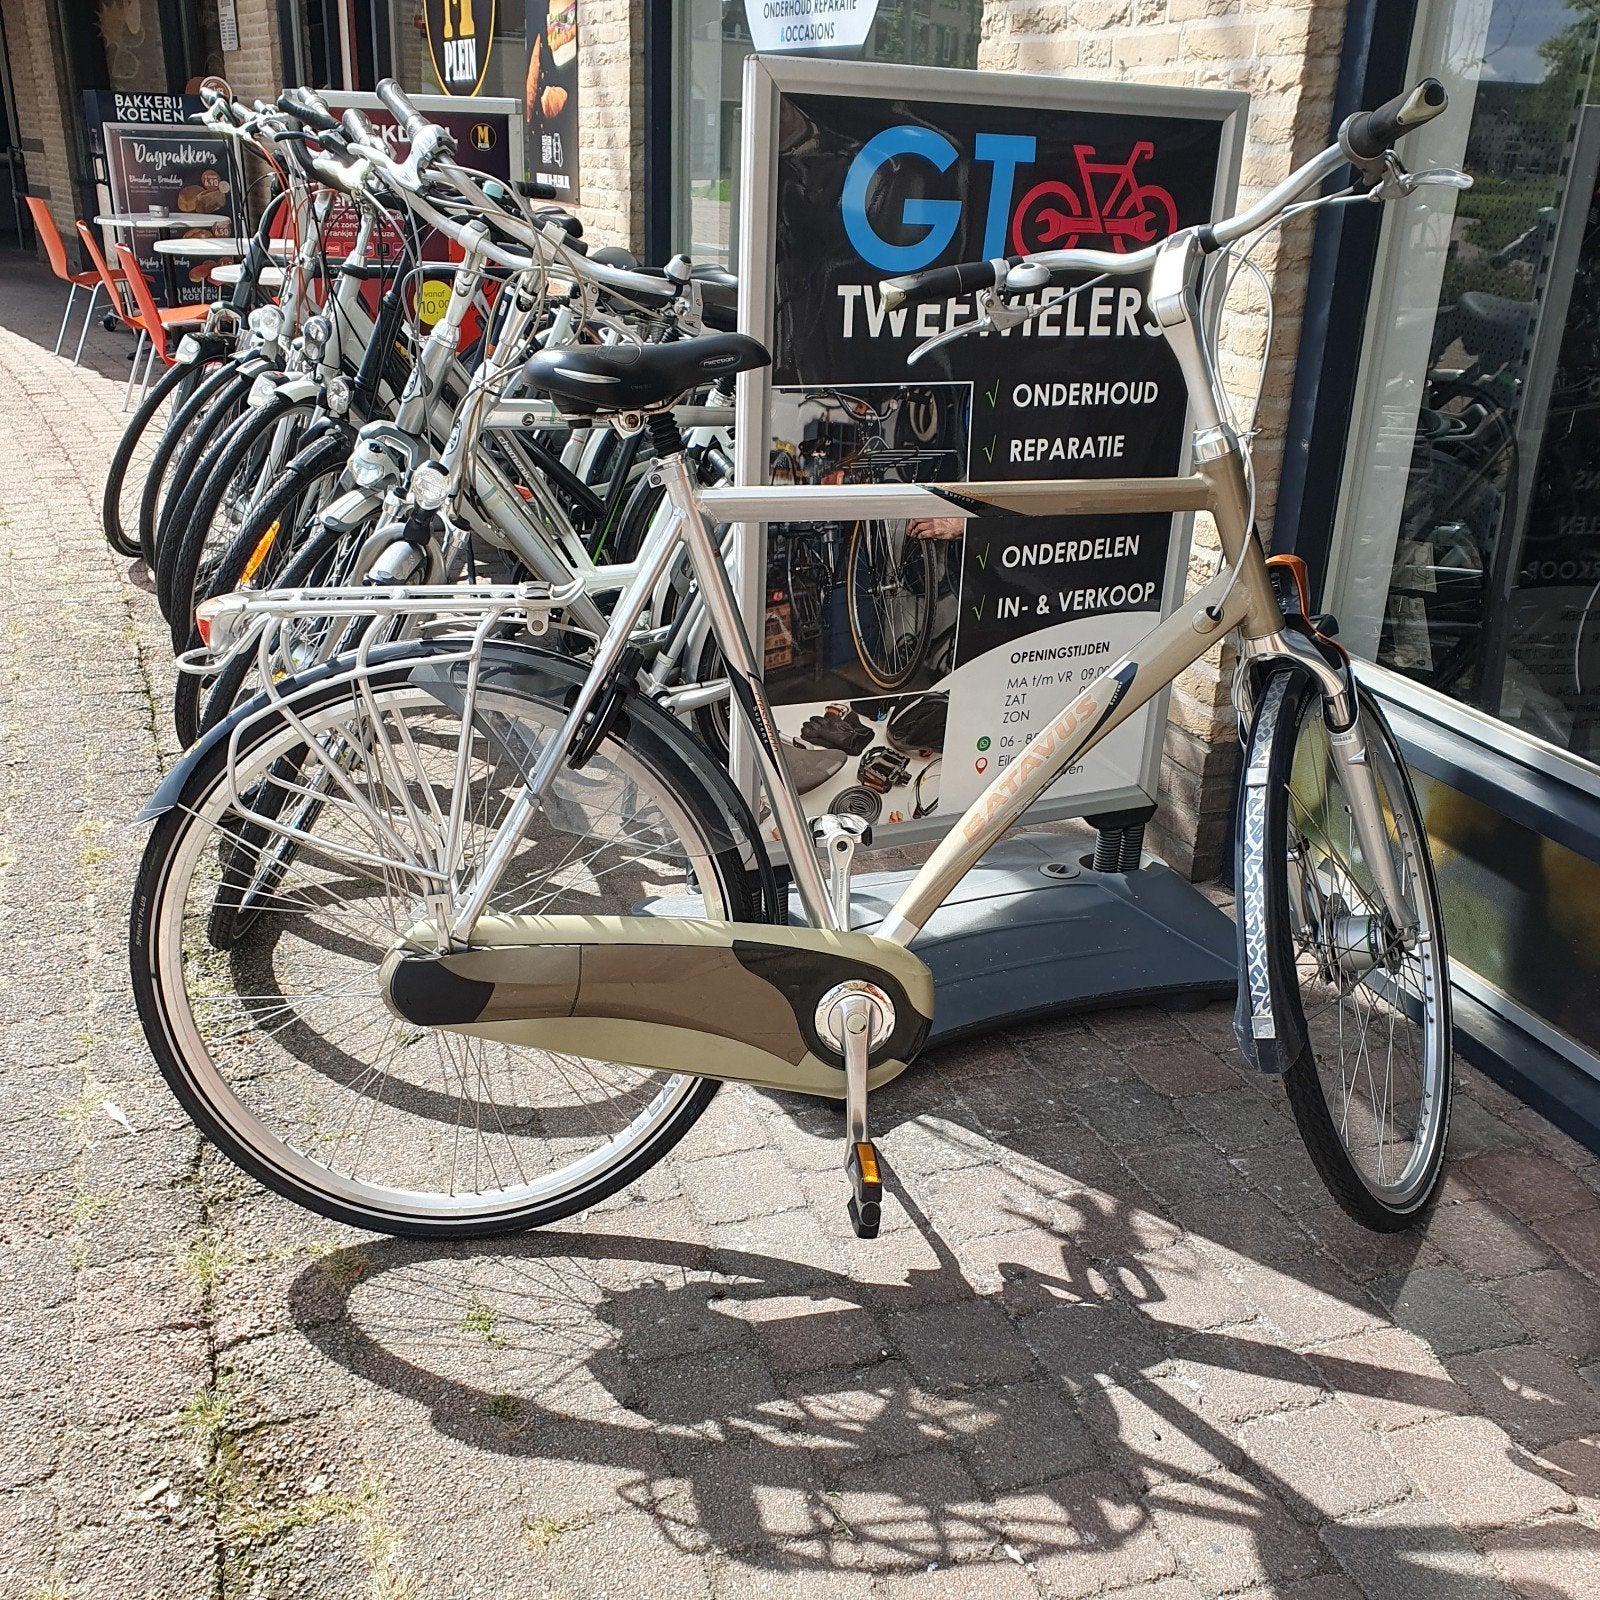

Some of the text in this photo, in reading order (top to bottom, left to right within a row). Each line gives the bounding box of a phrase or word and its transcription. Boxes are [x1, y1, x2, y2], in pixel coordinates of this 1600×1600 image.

[443, 38, 477, 82] PLEIN
[114, 94, 183, 109] BAKKERIJ
[116, 107, 185, 123] KOENEN
[204, 179, 219, 187] 6.90
[842, 125, 1037, 272] GT
[214, 228, 229, 236] 6.50
[424, 289, 445, 297] vanaf
[1012, 381, 1159, 408] ONDERHOUD
[1009, 434, 1126, 463] REPARATIE
[1001, 534, 1141, 568] ONDERDELEN
[997, 582, 1156, 620] IN- & VERKOOP
[1010, 641, 1111, 664] OPENINGSTIJDEN
[1007, 665, 1110, 689] MA t/m VR 09.0
[1005, 693, 1027, 707] ZAT
[752, 705, 769, 744] Supreme
[1003, 709, 1030, 724] ZON
[1000, 735, 1015, 747] 06
[962, 694, 1099, 844] BATAVUS
